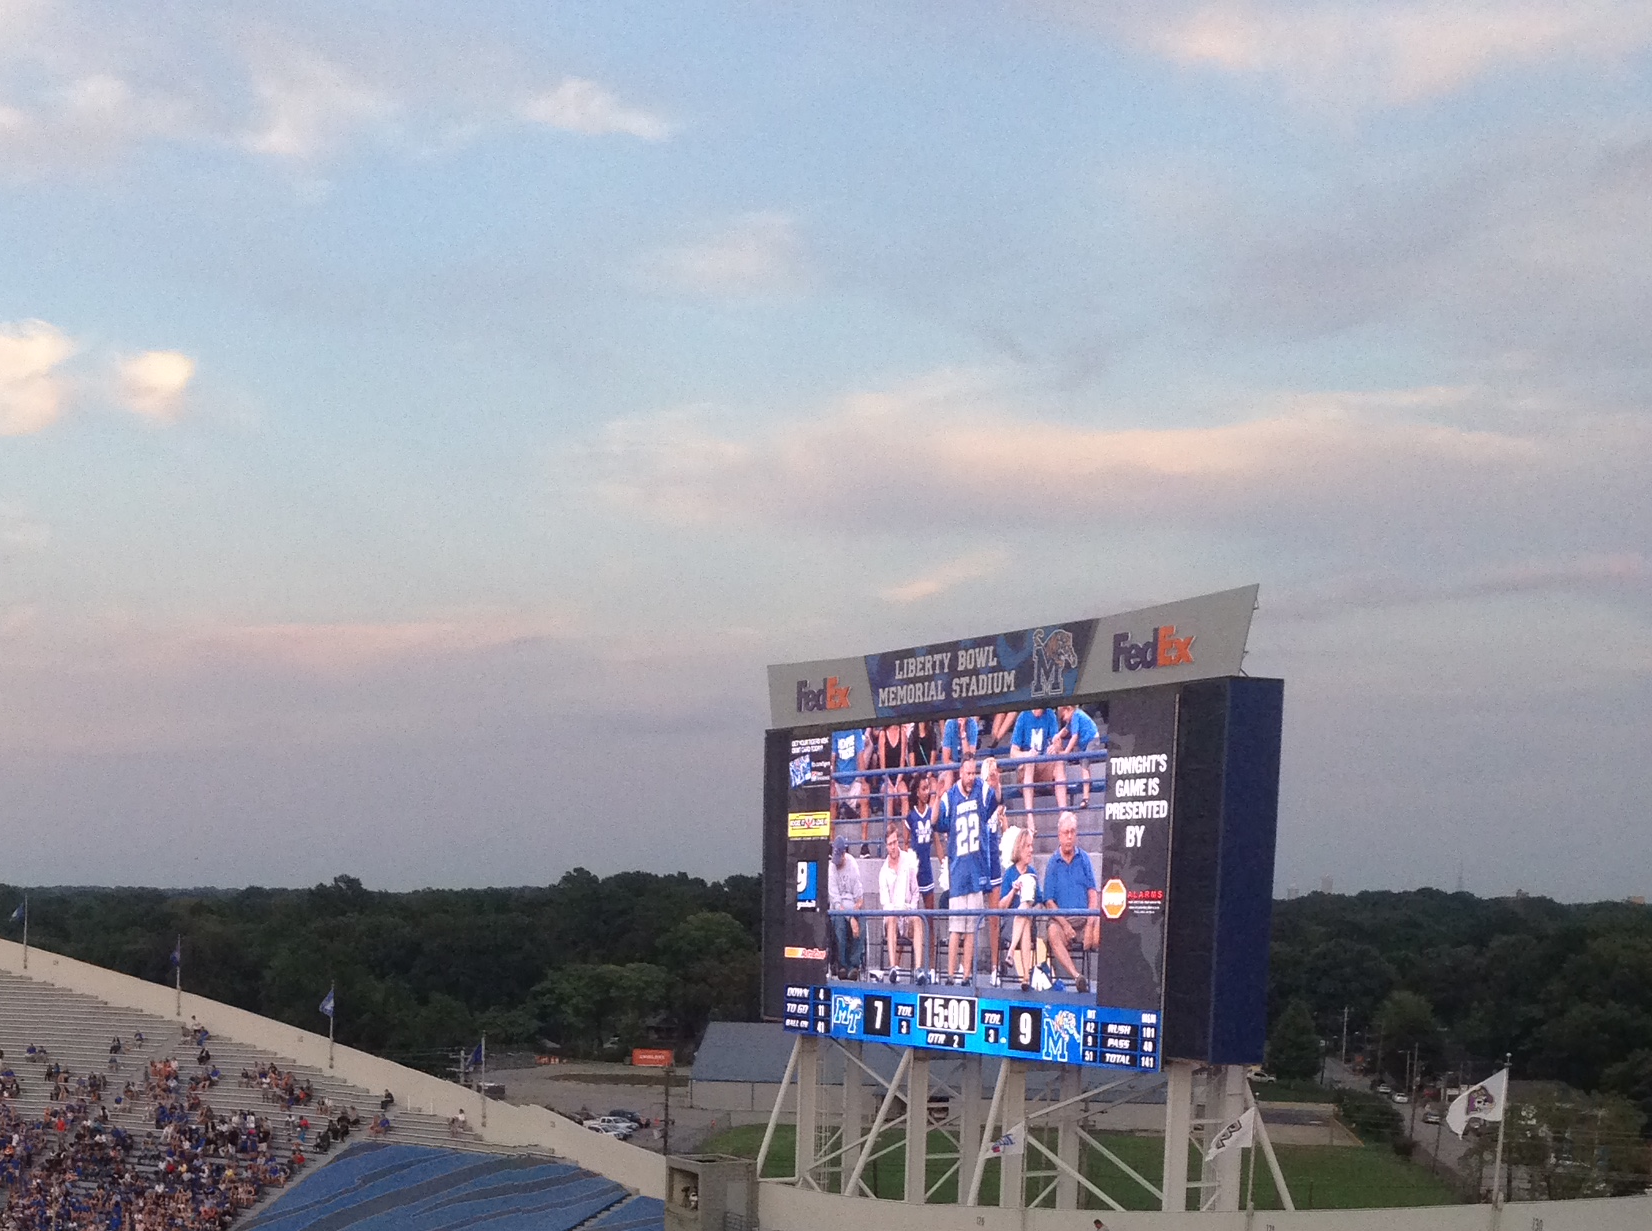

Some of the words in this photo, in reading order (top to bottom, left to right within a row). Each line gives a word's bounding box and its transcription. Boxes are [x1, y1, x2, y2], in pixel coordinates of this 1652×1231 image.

[1112, 625, 1196, 673] FedEx
[894, 651, 953, 680] LIBERTY
[957, 645, 998, 671] BOWL
[796, 676, 852, 712] FedEx
[878, 679, 946, 708] MEMORIAL
[951, 670, 1015, 697] STADIUM
[1110, 754, 1168, 775] TONIGHT'S
[1115, 779, 1147, 798] GAME
[1148, 778, 1160, 796] IS
[1105, 800, 1169, 820] PRESENTED
[955, 813, 980, 857] 22
[1125, 825, 1146, 848] BY
[1127, 890, 1163, 899] ALARMS
[786, 987, 810, 997] DOWN
[818, 988, 825, 1000] 4
[786, 1003, 796, 1013] TO
[797, 1003, 809, 1014] GO
[817, 1005, 825, 1017] 11
[874, 1000, 884, 1030] 7
[924, 998, 971, 1031] 15:00
[817, 1022, 825, 1033] 41
[900, 1021, 907, 1034] 3
[987, 1029, 995, 1043] 3
[1019, 1012, 1033, 1045] 9
[1086, 1022, 1095, 1033] 42
[1107, 1024, 1131, 1035] RUSH
[952, 1035, 960, 1048] 2
[1107, 1038, 1130, 1049] PASS
[1084, 1052, 1094, 1062] 51
[1105, 1053, 1131, 1065] TOTAL
[1141, 1056, 1154, 1068] 141
